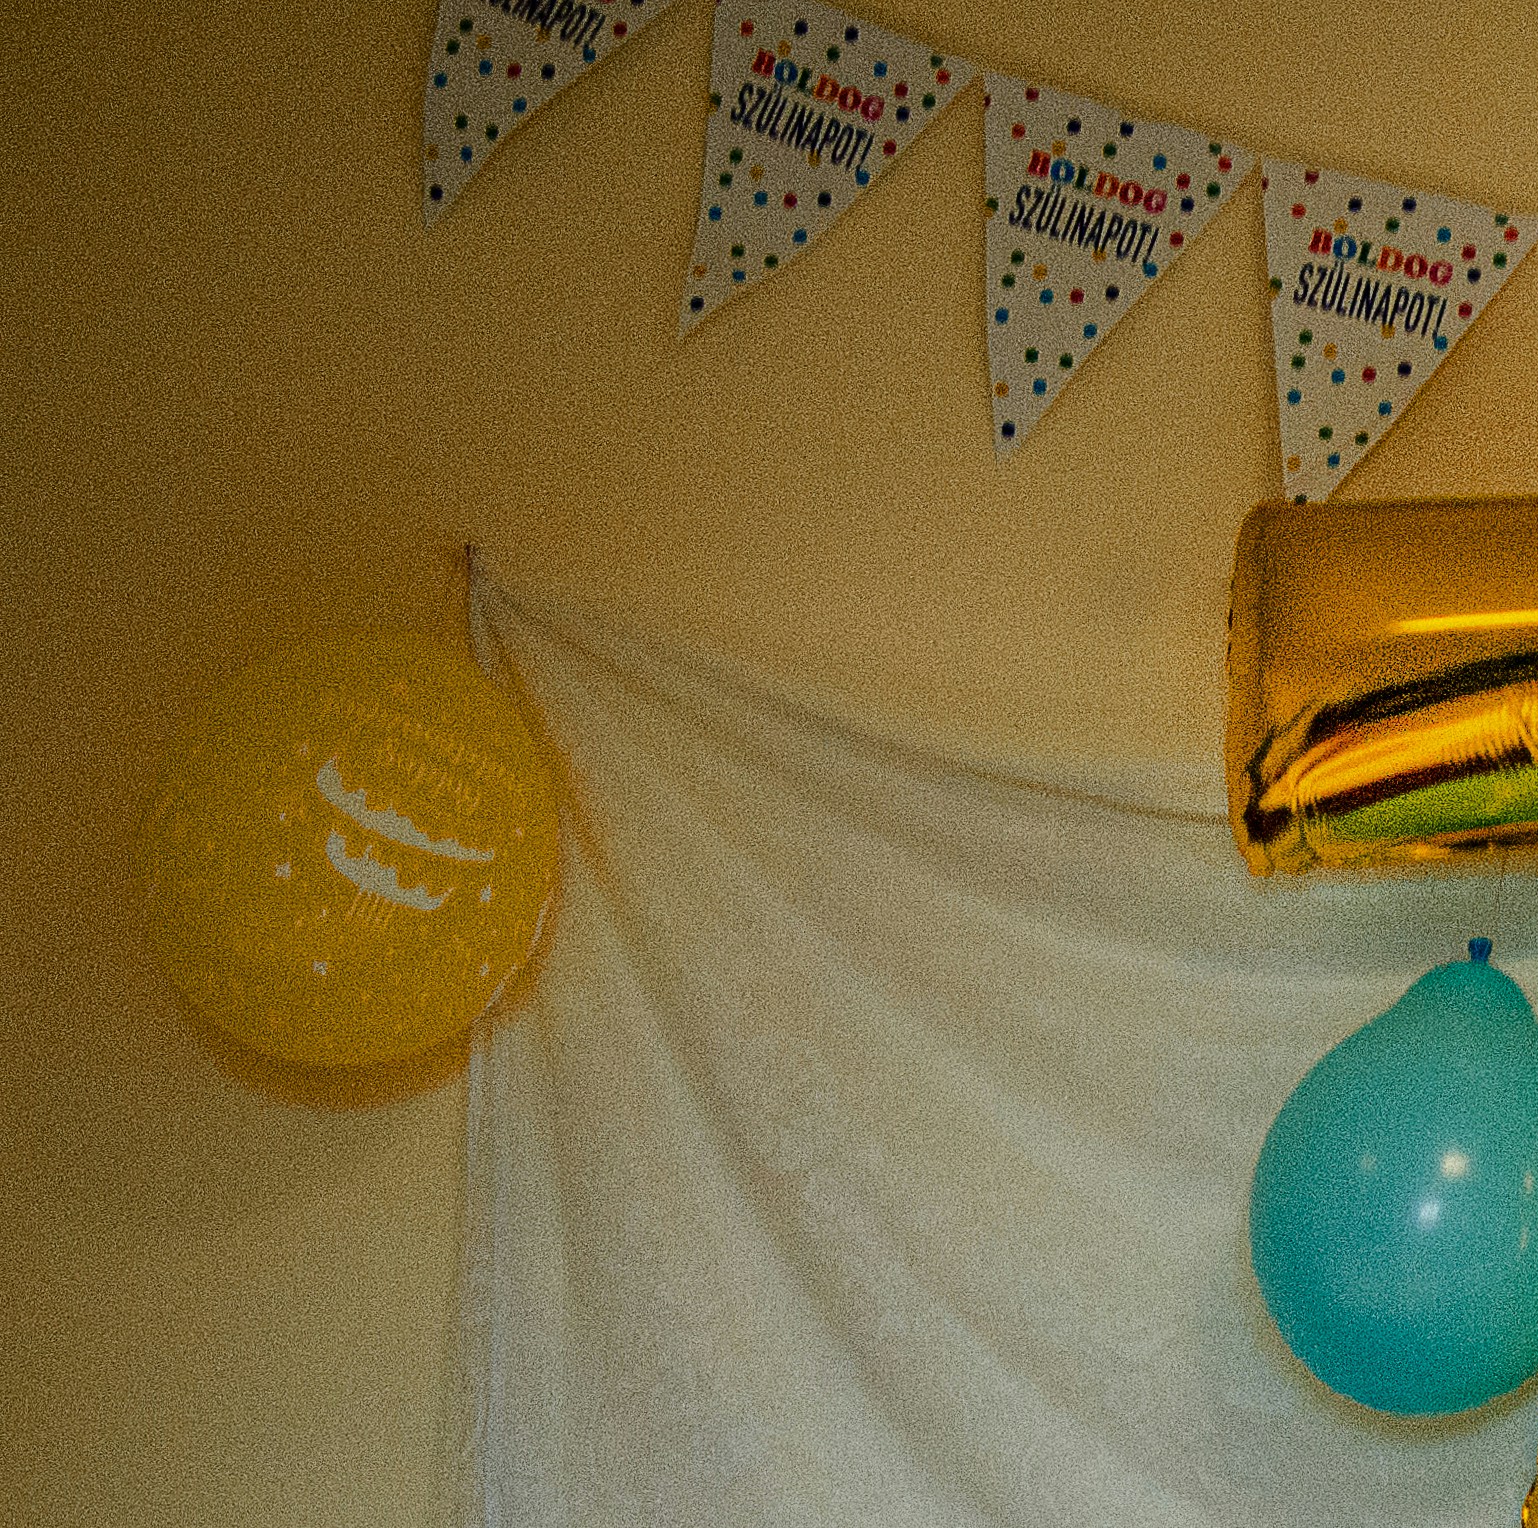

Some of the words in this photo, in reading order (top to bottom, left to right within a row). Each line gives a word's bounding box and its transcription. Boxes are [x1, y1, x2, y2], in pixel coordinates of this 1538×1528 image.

[751, 49, 884, 121] BOLDOG
[731, 83, 875, 173] SZÜLINAPOT!
[1027, 149, 1168, 215] BOLDOG
[1009, 184, 1160, 266] SZÜLINAPOT!
[1309, 228, 1453, 286] BOLDOG
[1292, 261, 1448, 339] SZÜLINAPOT!
